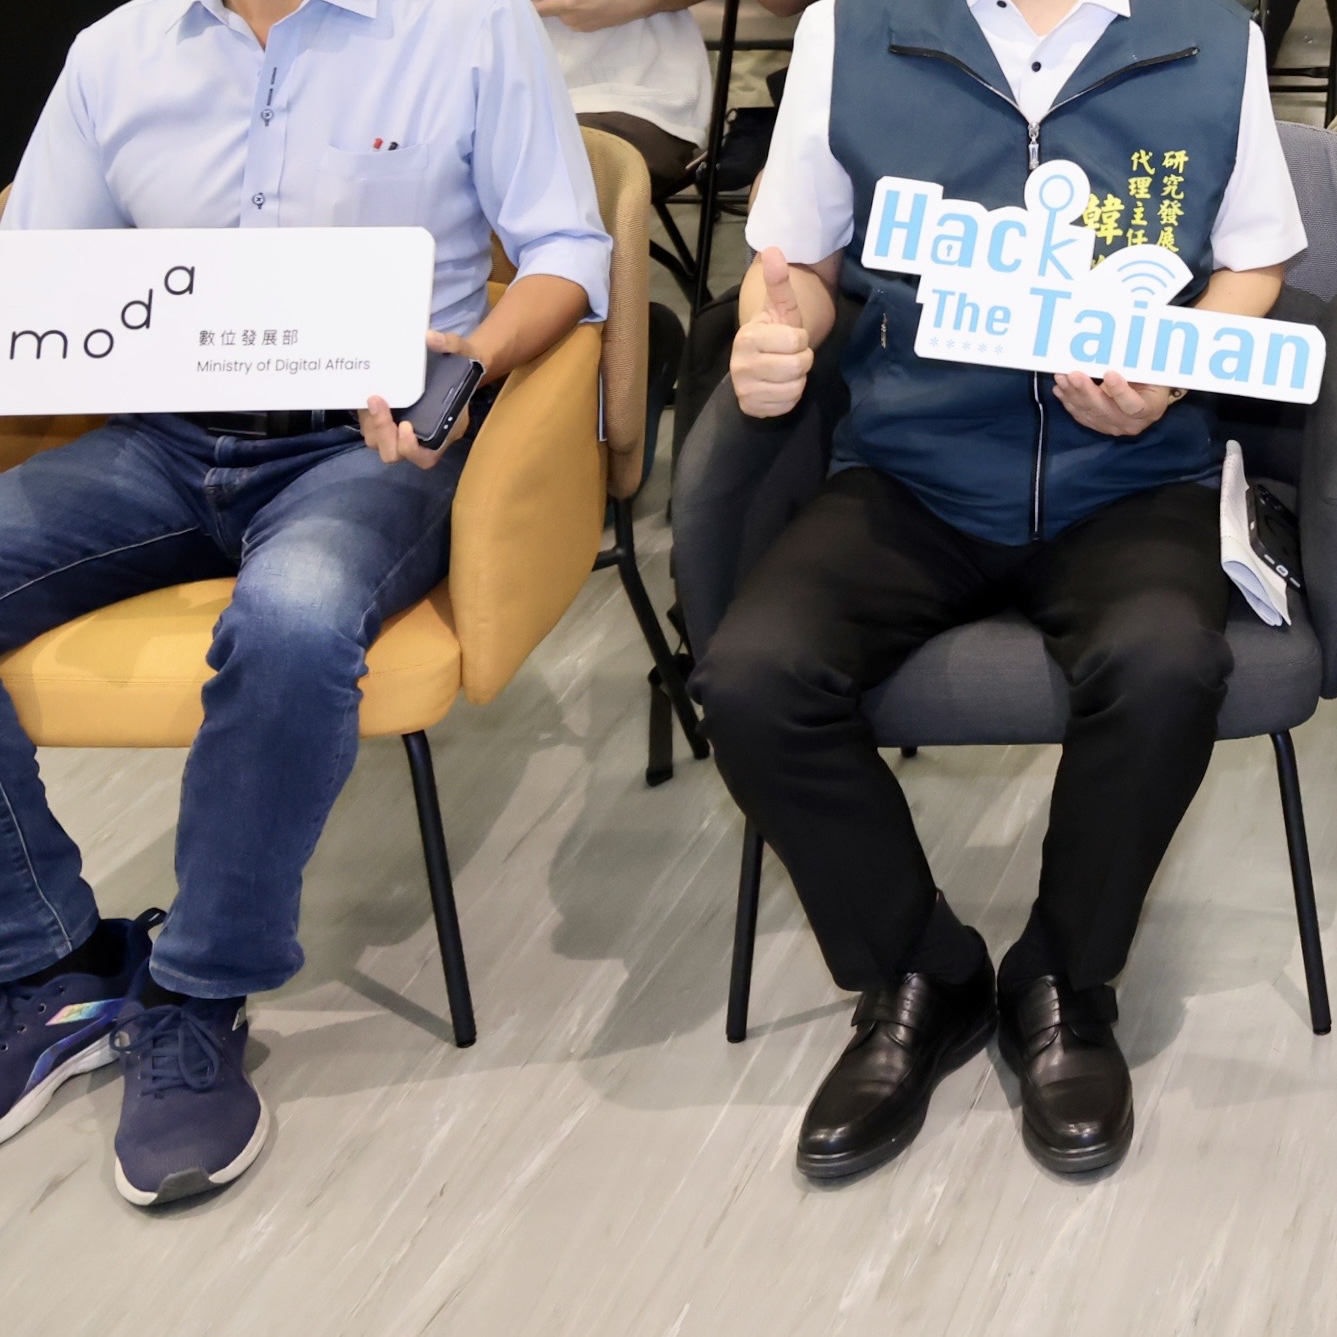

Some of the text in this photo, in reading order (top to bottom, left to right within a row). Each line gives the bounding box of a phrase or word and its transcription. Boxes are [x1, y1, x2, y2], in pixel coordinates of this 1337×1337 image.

[874, 174, 1079, 281] Hack
[1083, 193, 1125, 268] 韓
[9, 265, 195, 360] moda
[199, 329, 299, 347] 數位發展部
[932, 287, 1312, 390] The Tainan
[196, 357, 371, 375] Ministry of Digital Affairs
